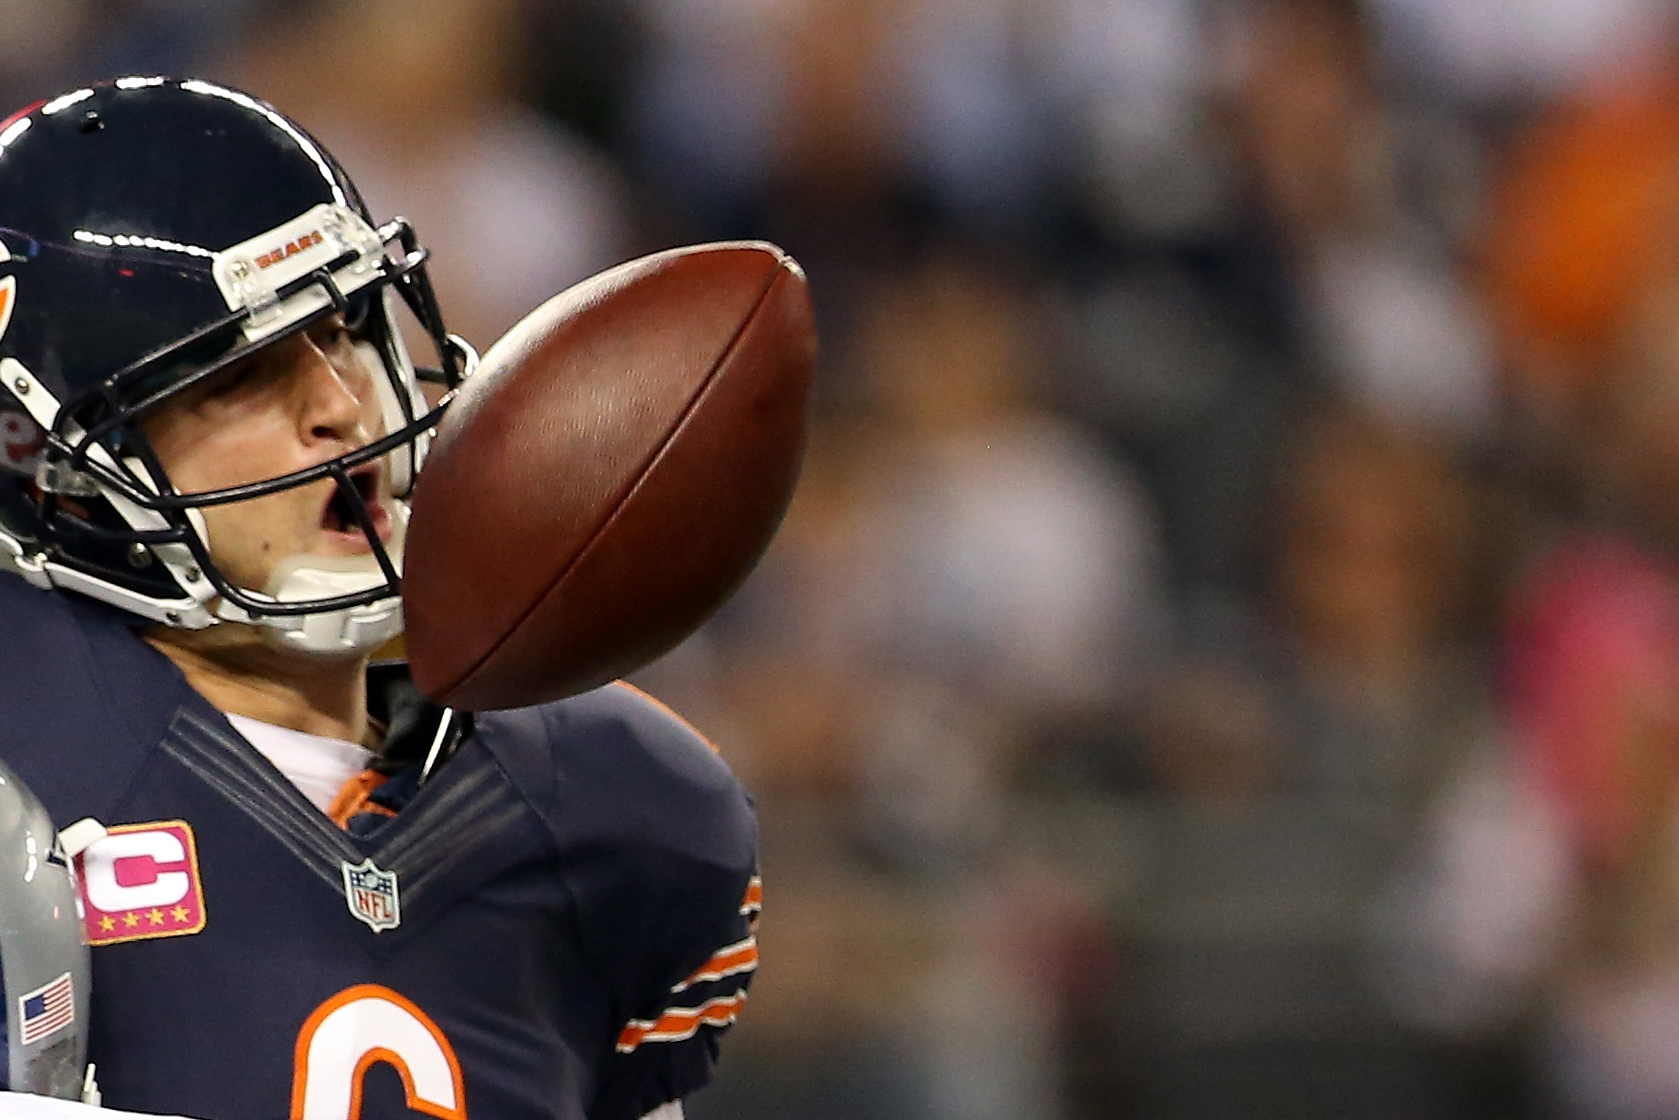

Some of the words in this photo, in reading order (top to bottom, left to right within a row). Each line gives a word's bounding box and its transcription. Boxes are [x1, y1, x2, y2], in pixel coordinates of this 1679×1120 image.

[254, 230, 323, 269] BEARS
[84, 831, 189, 912] C
[354, 887, 394, 920] NFL
